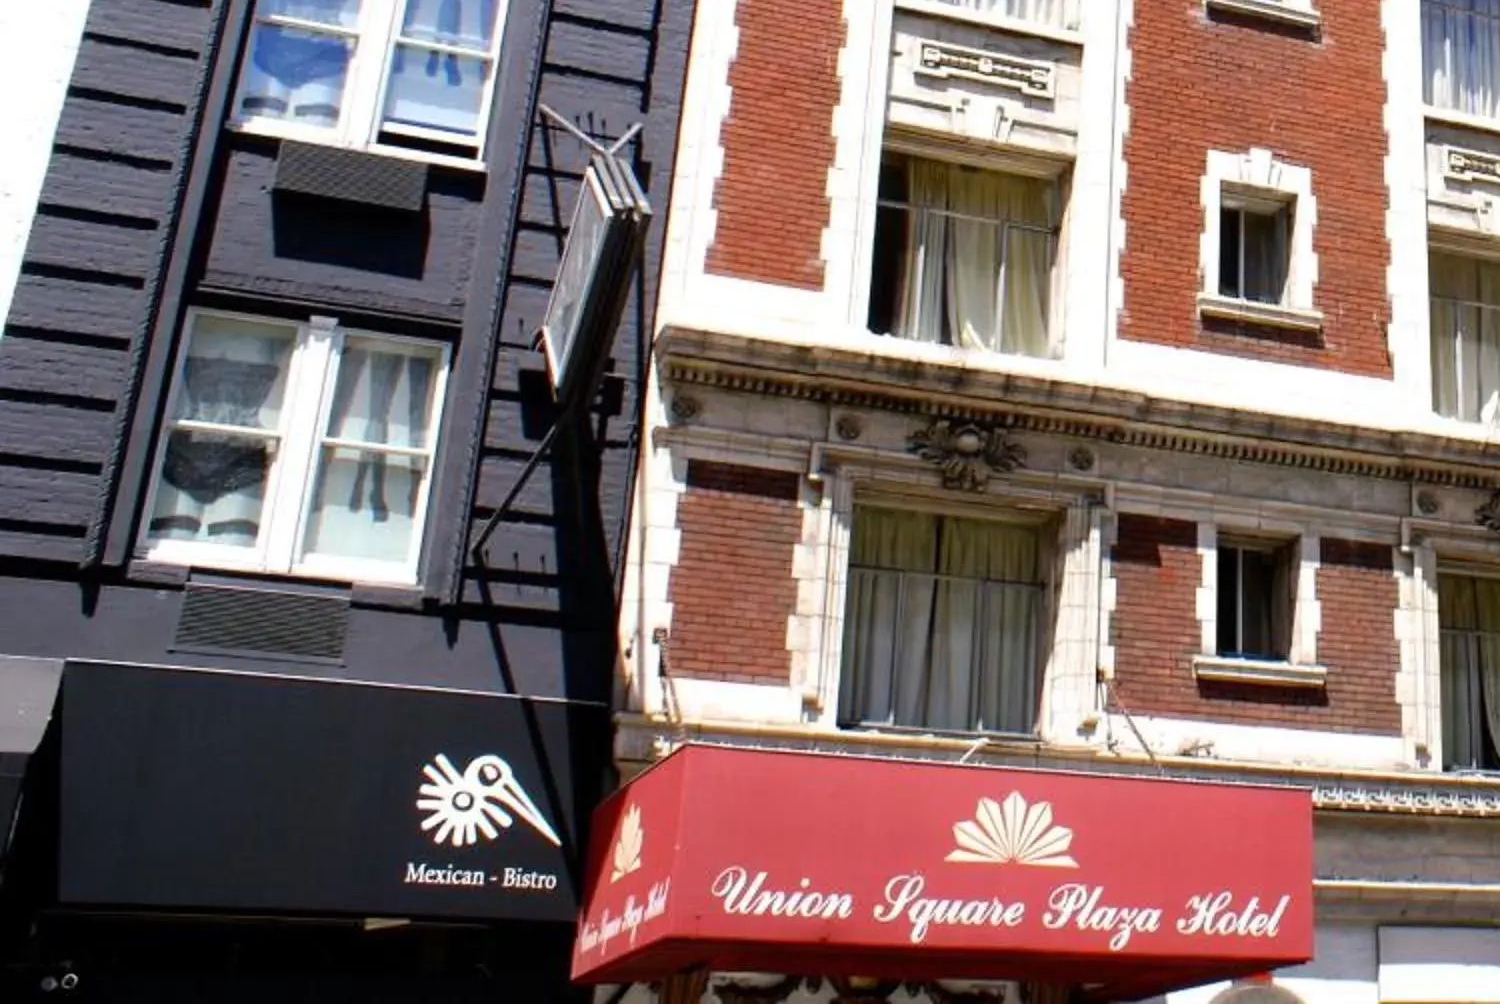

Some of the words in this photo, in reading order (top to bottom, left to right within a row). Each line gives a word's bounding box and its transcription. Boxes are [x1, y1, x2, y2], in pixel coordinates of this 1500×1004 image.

[404, 862, 485, 885] Mexican
[502, 867, 558, 890] Bistro
[711, 866, 852, 919] Union
[873, 875, 1024, 943] Square
[1042, 885, 1161, 952] Plaza
[1176, 892, 1289, 938] Hotel
